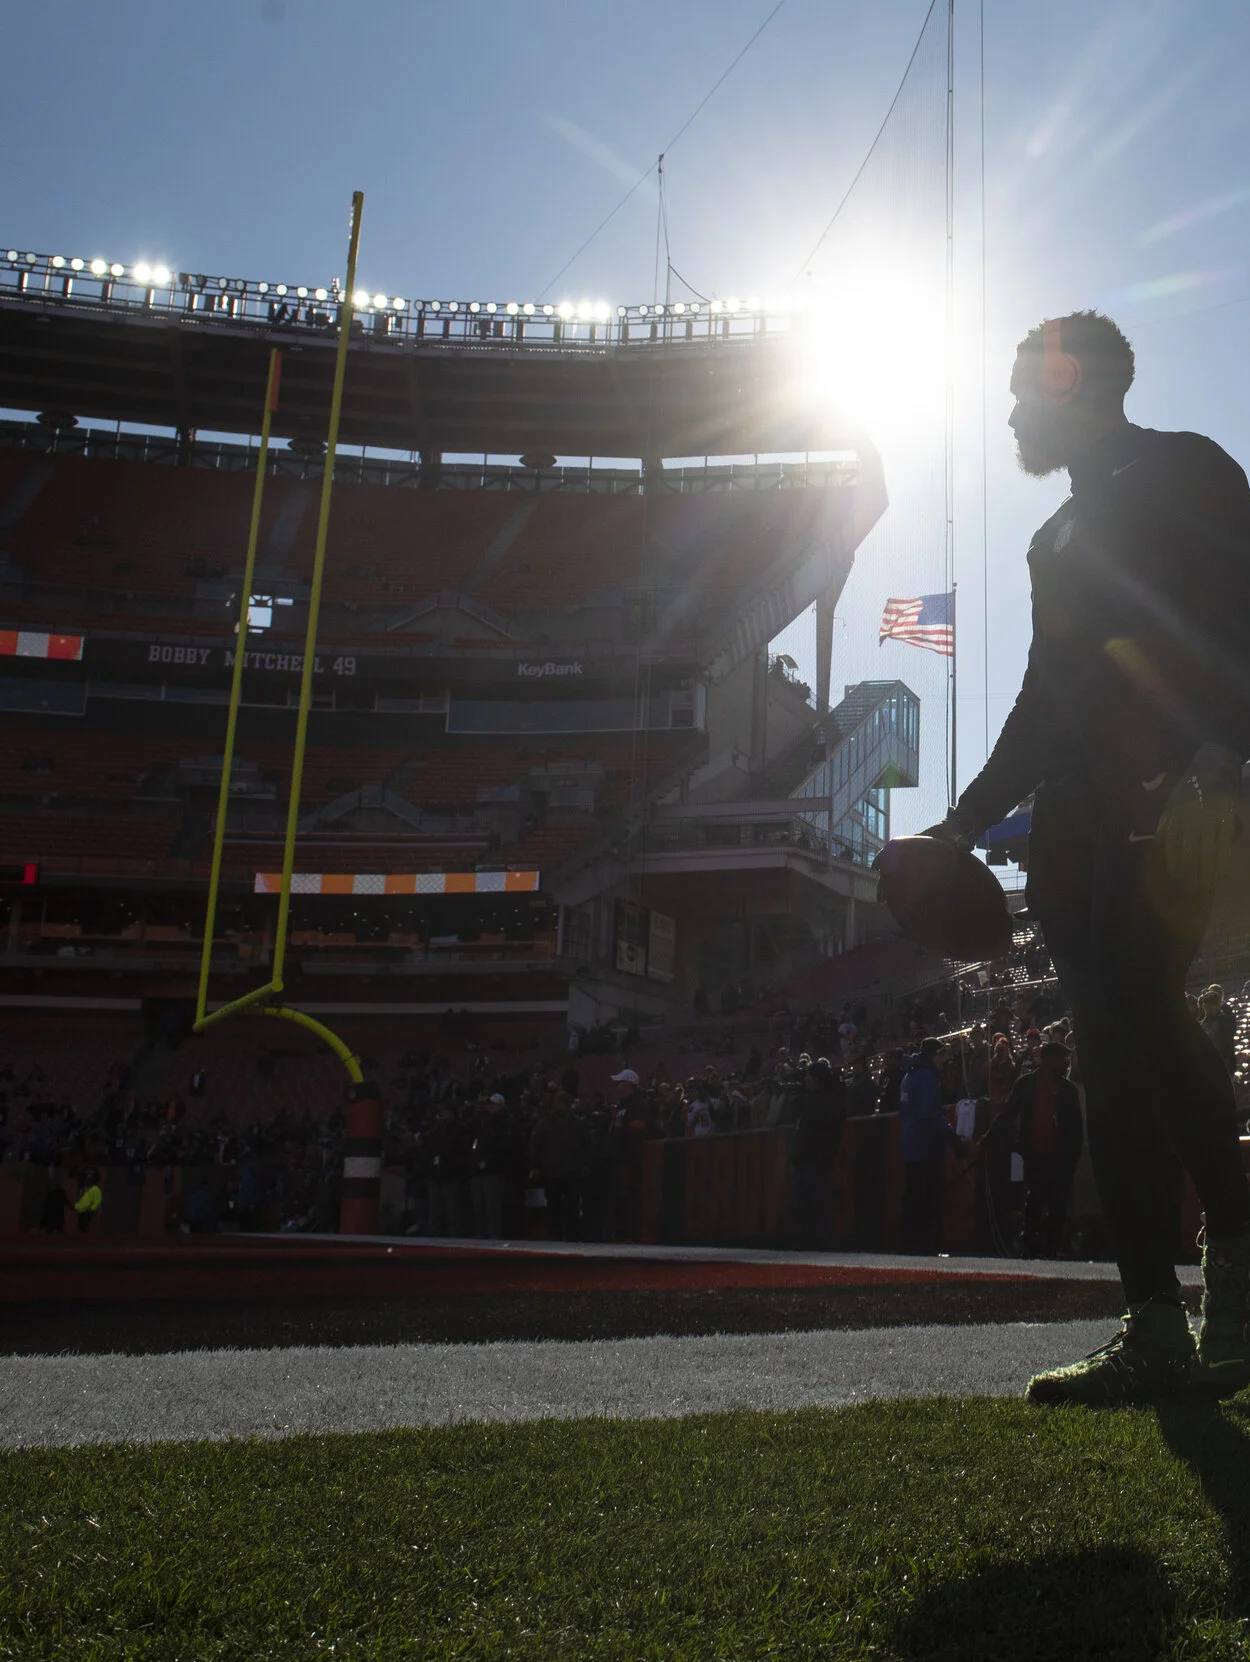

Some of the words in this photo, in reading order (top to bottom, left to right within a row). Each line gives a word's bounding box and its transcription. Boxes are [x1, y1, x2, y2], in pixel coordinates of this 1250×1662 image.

[149, 645, 211, 666] BOBBY
[224, 650, 325, 674] MITCHEL
[332, 656, 357, 676] 49
[518, 662, 583, 678] KeyBank
